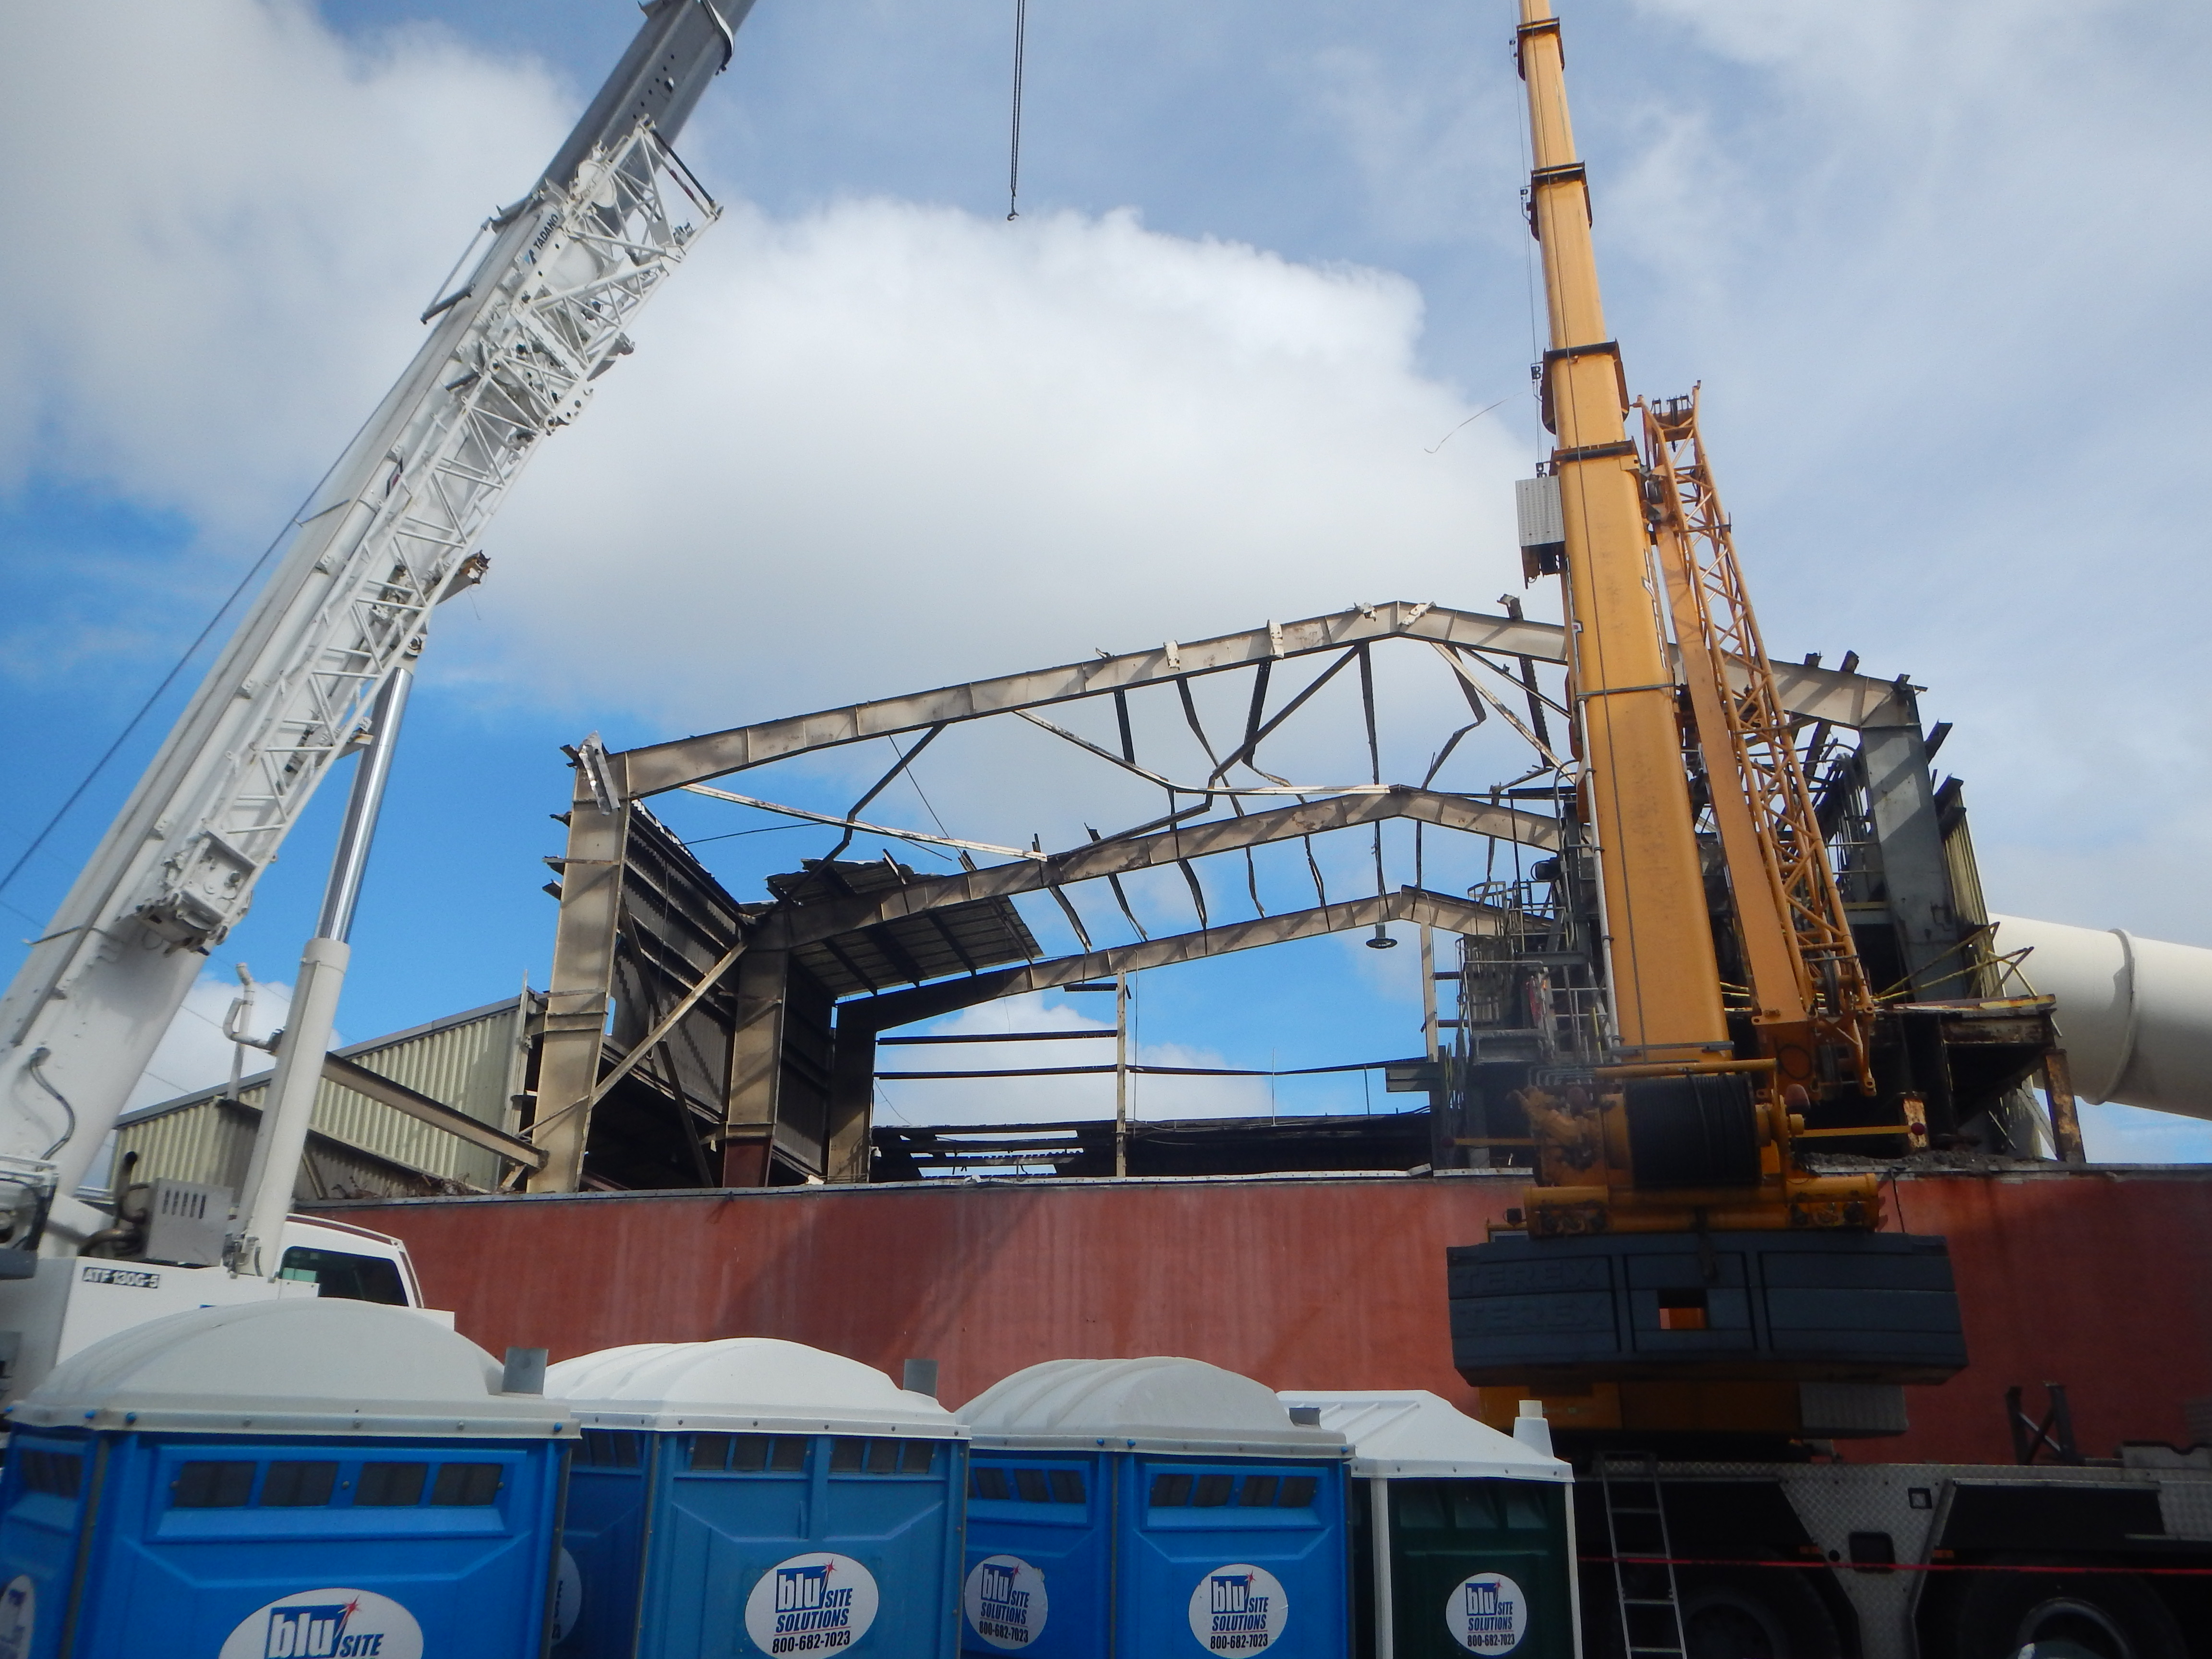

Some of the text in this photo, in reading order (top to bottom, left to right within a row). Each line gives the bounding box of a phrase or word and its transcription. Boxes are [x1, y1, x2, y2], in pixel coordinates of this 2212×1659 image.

[533, 214, 558, 250] TADANO
[83, 1268, 111, 1283] ATF
[778, 1573, 853, 1610] blu SITE
[982, 1568, 1030, 1608] blu SITE
[1212, 1580, 1269, 1612] blu SITE
[1467, 1587, 1513, 1615] blu SITE
[776, 1608, 849, 1633] SOLUTIONS
[981, 1602, 1027, 1624] SOLUTIONS
[1212, 1614, 1266, 1631] SOLUTIONS
[1468, 1616, 1512, 1631] SOLUTIONS
[268, 1612, 384, 1658] blu SITE
[772, 1630, 851, 1653] 800-682-7023
[979, 1621, 1028, 1643] 800-682-7023
[1210, 1634, 1268, 1649] 800-682-7023
[1467, 1634, 1515, 1647] 800-682-7023
